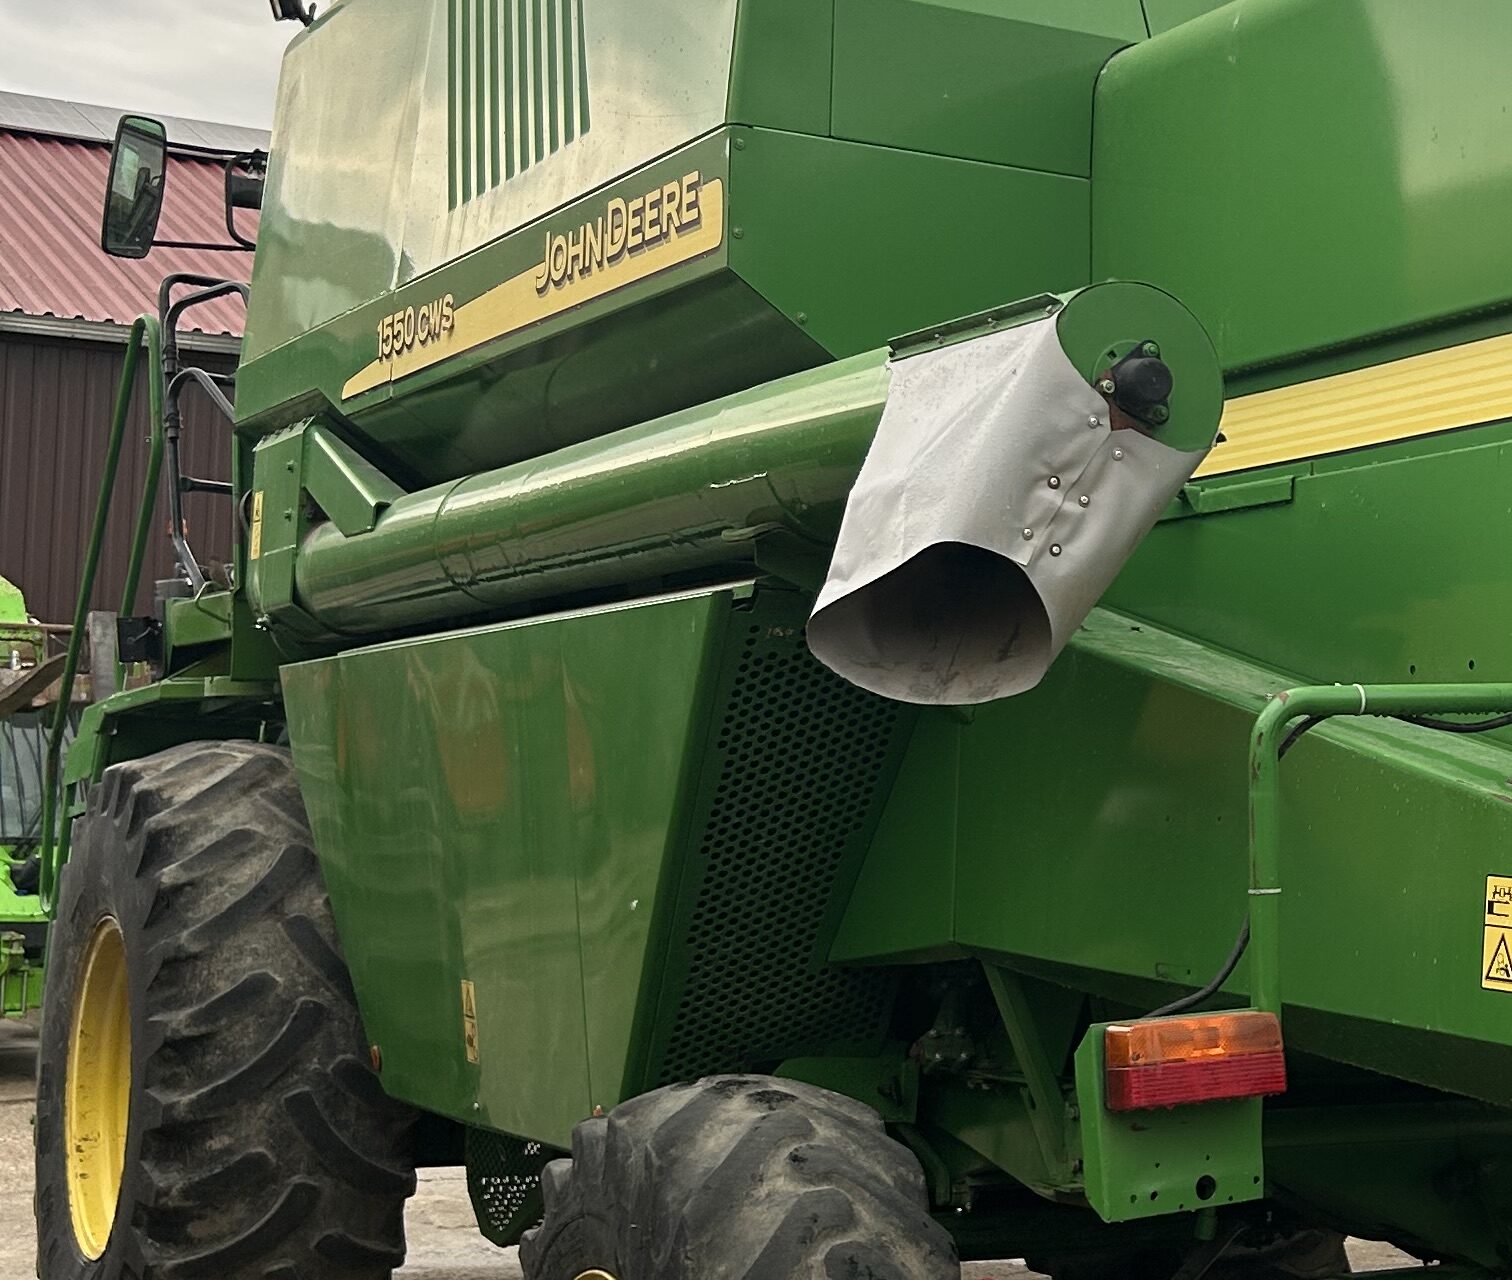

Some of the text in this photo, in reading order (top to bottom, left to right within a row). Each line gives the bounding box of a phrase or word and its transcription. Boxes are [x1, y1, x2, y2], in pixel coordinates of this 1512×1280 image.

[536, 170, 700, 291] JOHN DEERE
[377, 293, 454, 361] 1550 CWS
